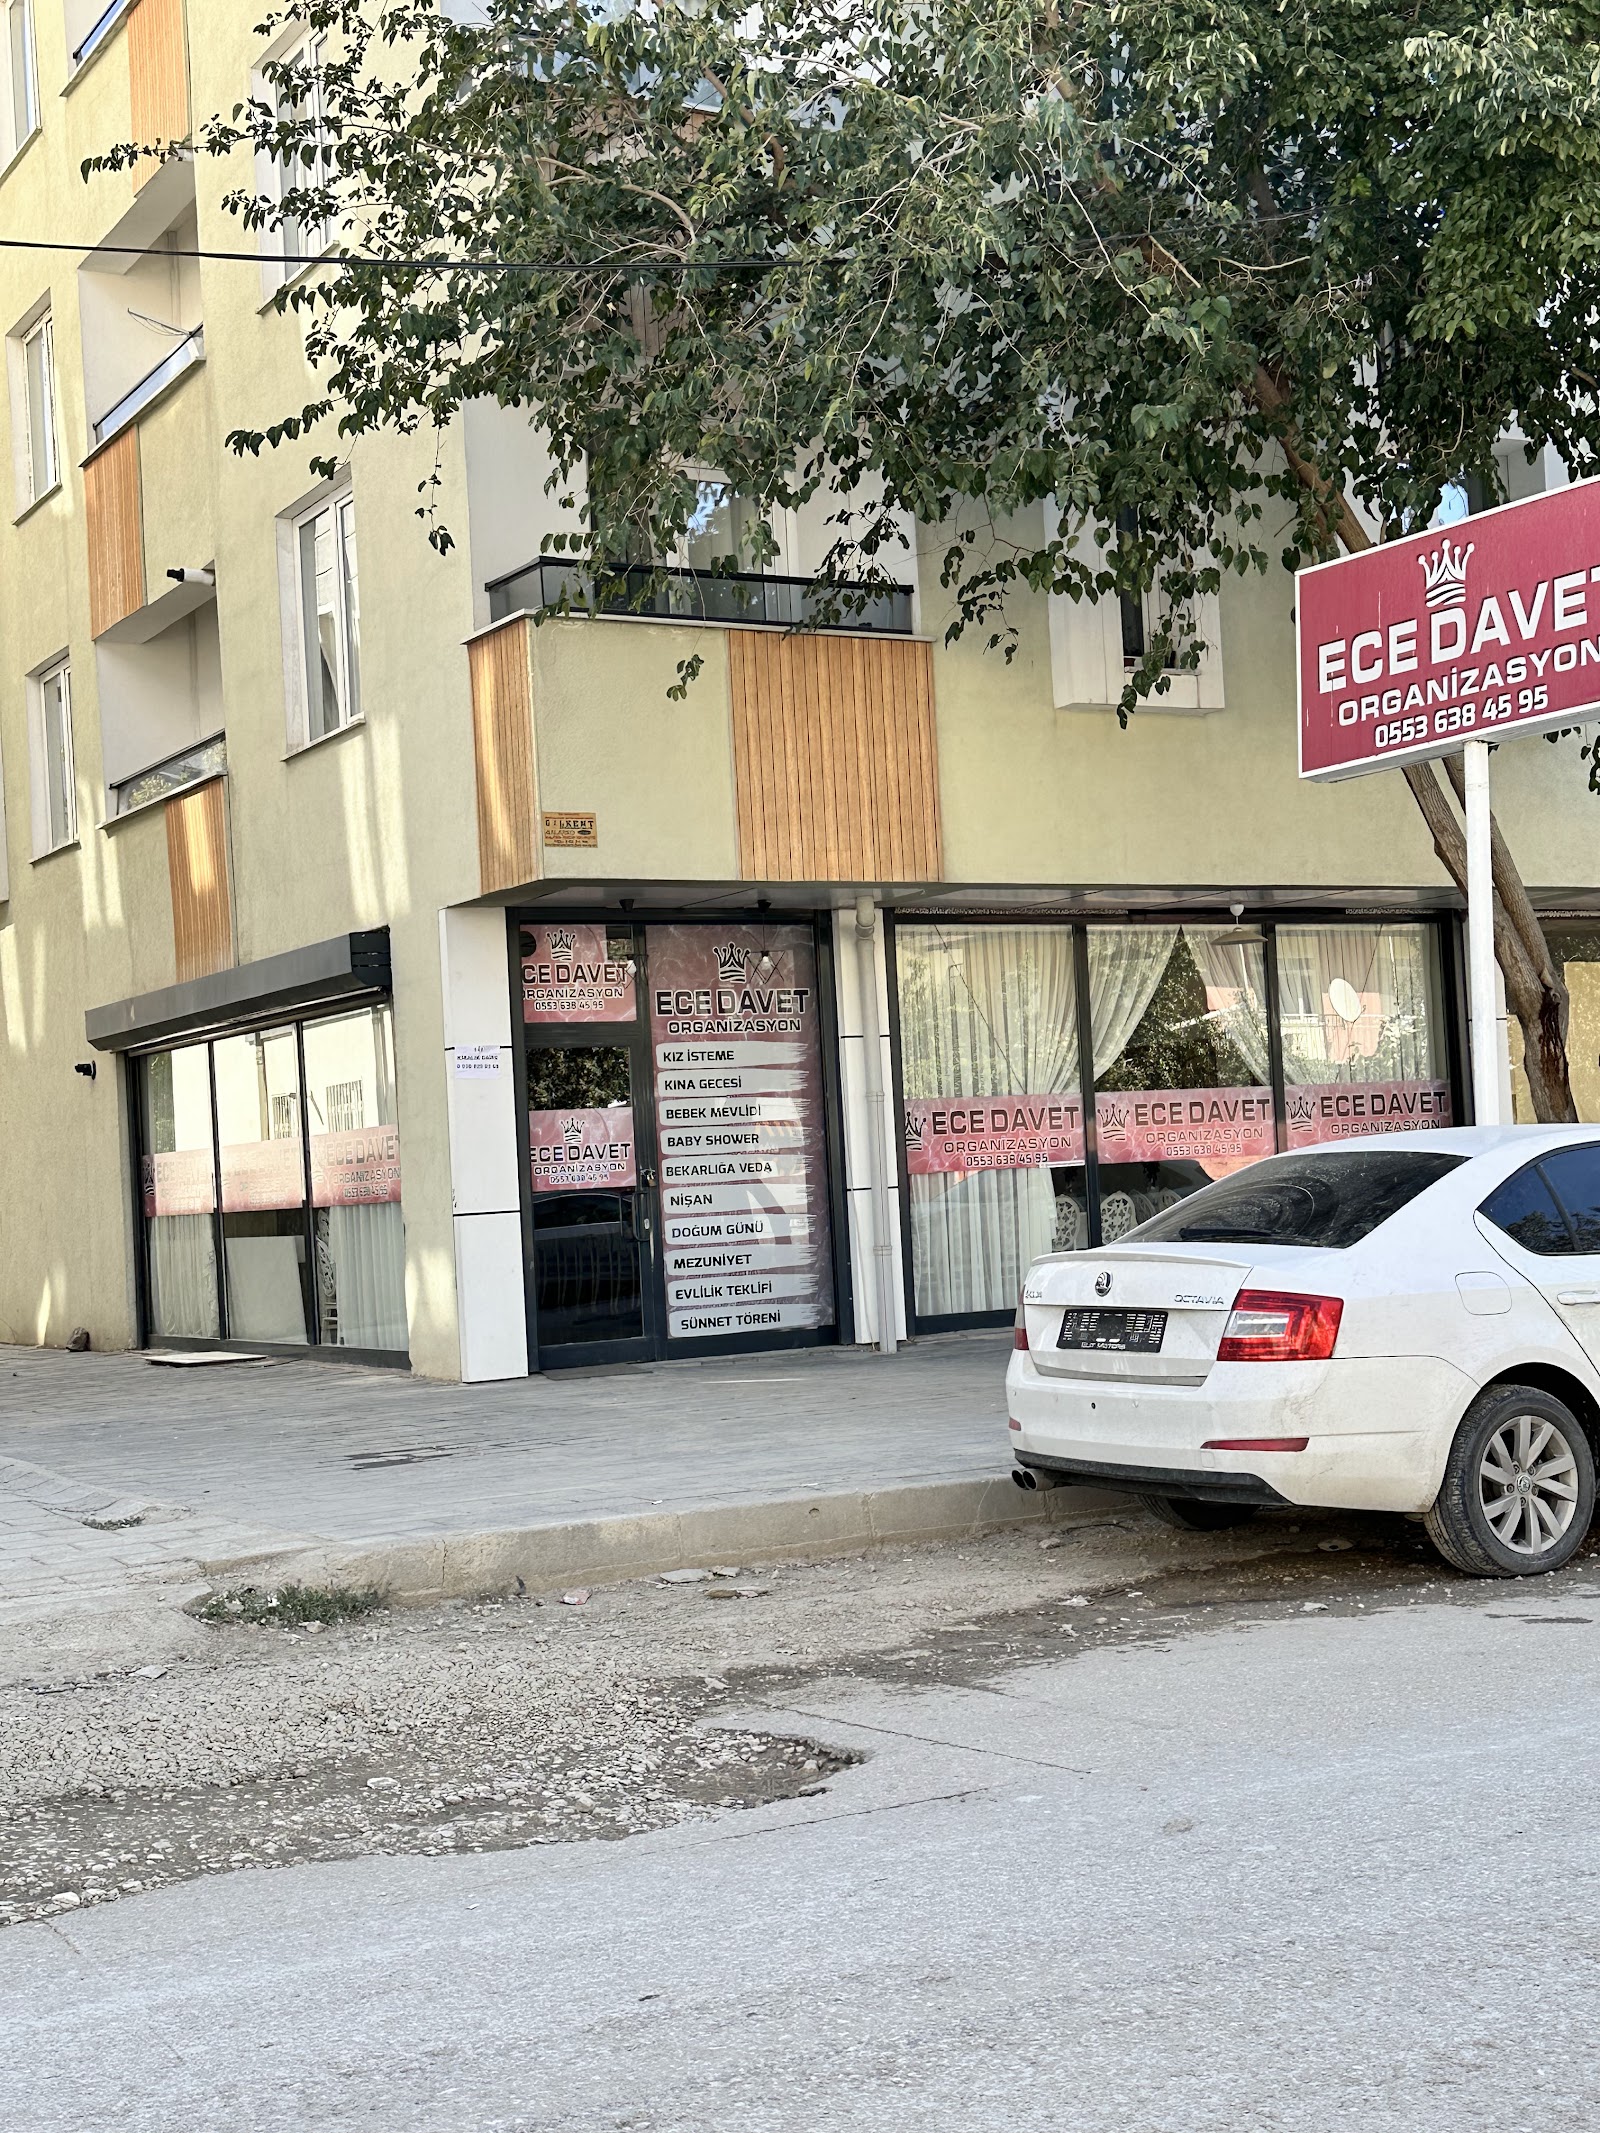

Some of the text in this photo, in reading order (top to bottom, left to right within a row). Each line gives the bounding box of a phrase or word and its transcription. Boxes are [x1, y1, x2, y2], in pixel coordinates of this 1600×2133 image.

[1318, 564, 1600, 694] ECE DAVE
[1337, 635, 1600, 726] ORGANİZASYON
[1375, 684, 1548, 748] 0553 638 45 95
[521, 962, 629, 984] CE DAVET
[535, 1000, 604, 1011] 0553 638 45 95
[656, 988, 809, 1016] ECE DAVET
[668, 1017, 801, 1034] ORGANİZASYON
[663, 1049, 735, 1062] KIZ İSTEME
[664, 1075, 742, 1091] KINA GECESİ
[666, 1104, 761, 1119] BEBEK MEVLİDİ
[1134, 1098, 1270, 1126] ECE DAVET
[1320, 1091, 1446, 1118] ECE DAVET
[932, 1106, 1079, 1135] ECE DAVET
[667, 1133, 759, 1147] BABY SHOWER
[327, 1141, 353, 1166] ECE
[567, 1143, 631, 1161] DAVET
[1166, 1143, 1242, 1156] 0553 638 45 95
[966, 1152, 1048, 1166] 0553 638 45 95
[666, 1161, 773, 1177] BEKARLIĞA VEDA
[670, 1193, 713, 1208] NİŞAN
[671, 1220, 764, 1238] DOĞUM GÜNÜ
[674, 1253, 752, 1269] MEZUNİYET
[675, 1280, 773, 1300] EVLİLİK TEKLİFİ
[1174, 1294, 1225, 1305] OCTAVIA
[681, 1309, 781, 1330] SÜNNET TÖRENİ
